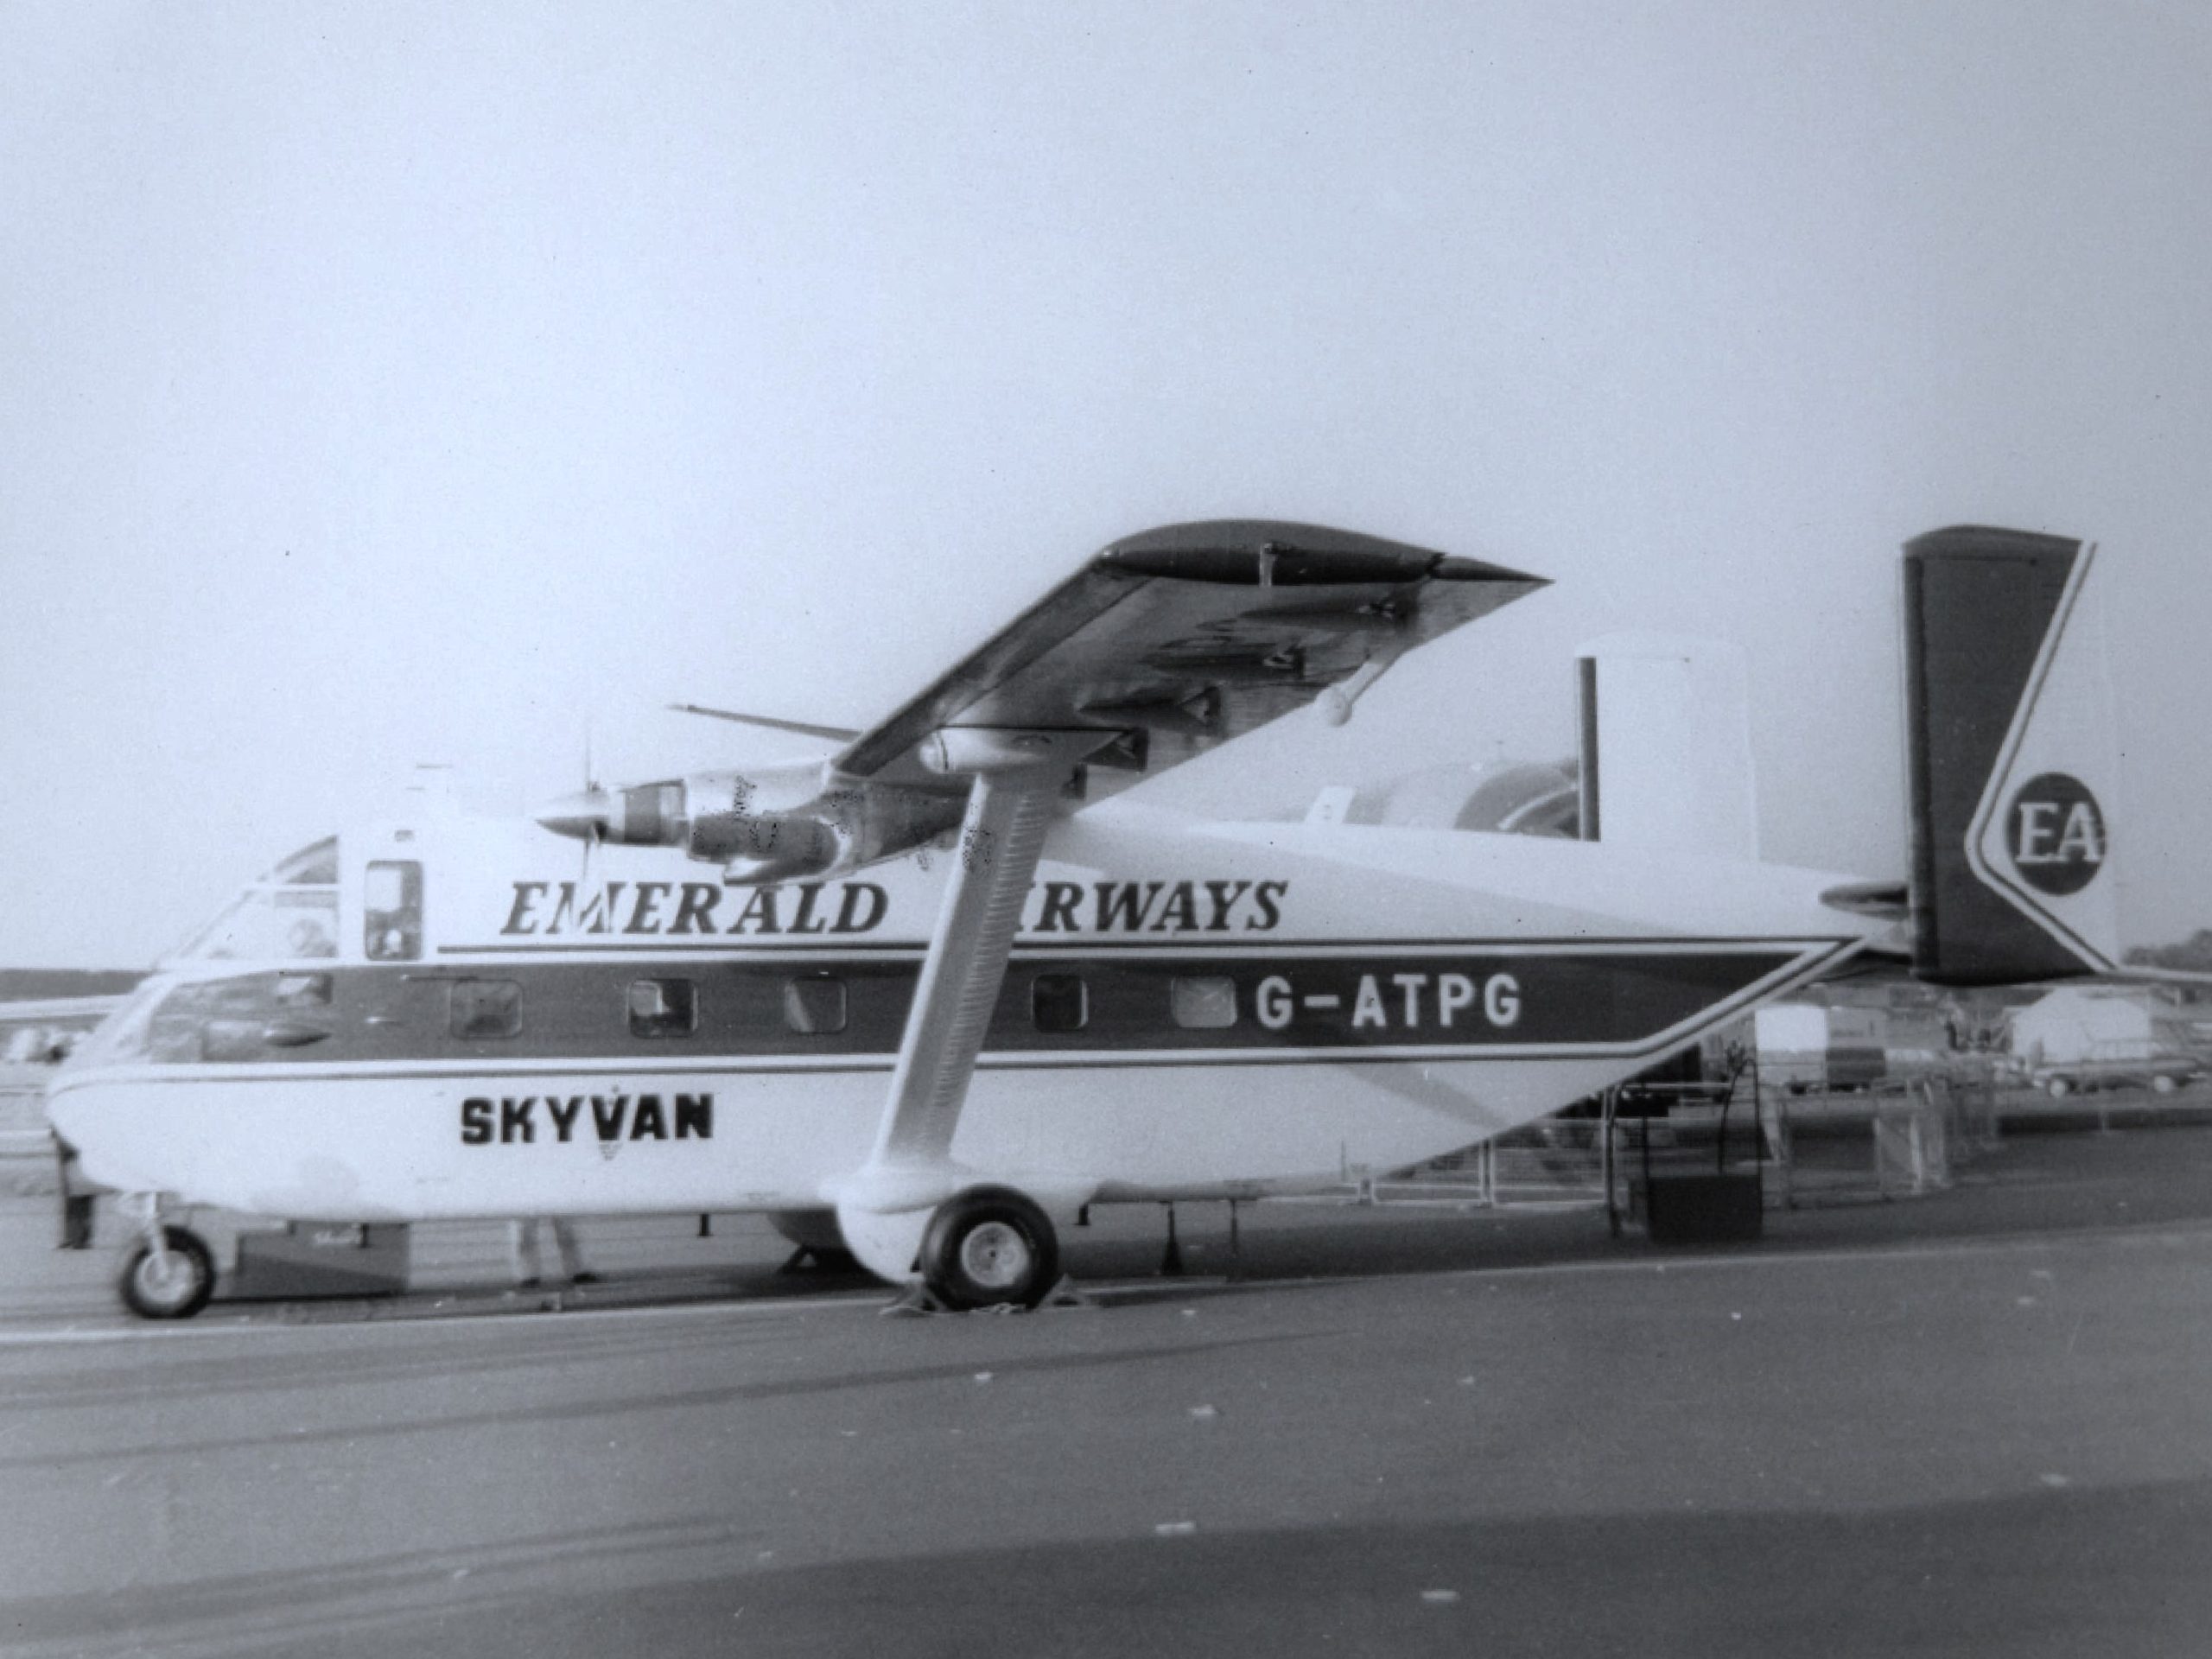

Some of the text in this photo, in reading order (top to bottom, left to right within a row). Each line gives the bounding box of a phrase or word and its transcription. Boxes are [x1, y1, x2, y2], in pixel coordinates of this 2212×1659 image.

[2016, 802, 2101, 862] EA
[499, 880, 1290, 935] EMERALD RWAYS
[1255, 974, 1522, 1029] G-ATPG
[461, 1092, 714, 1145] SKYVAN
